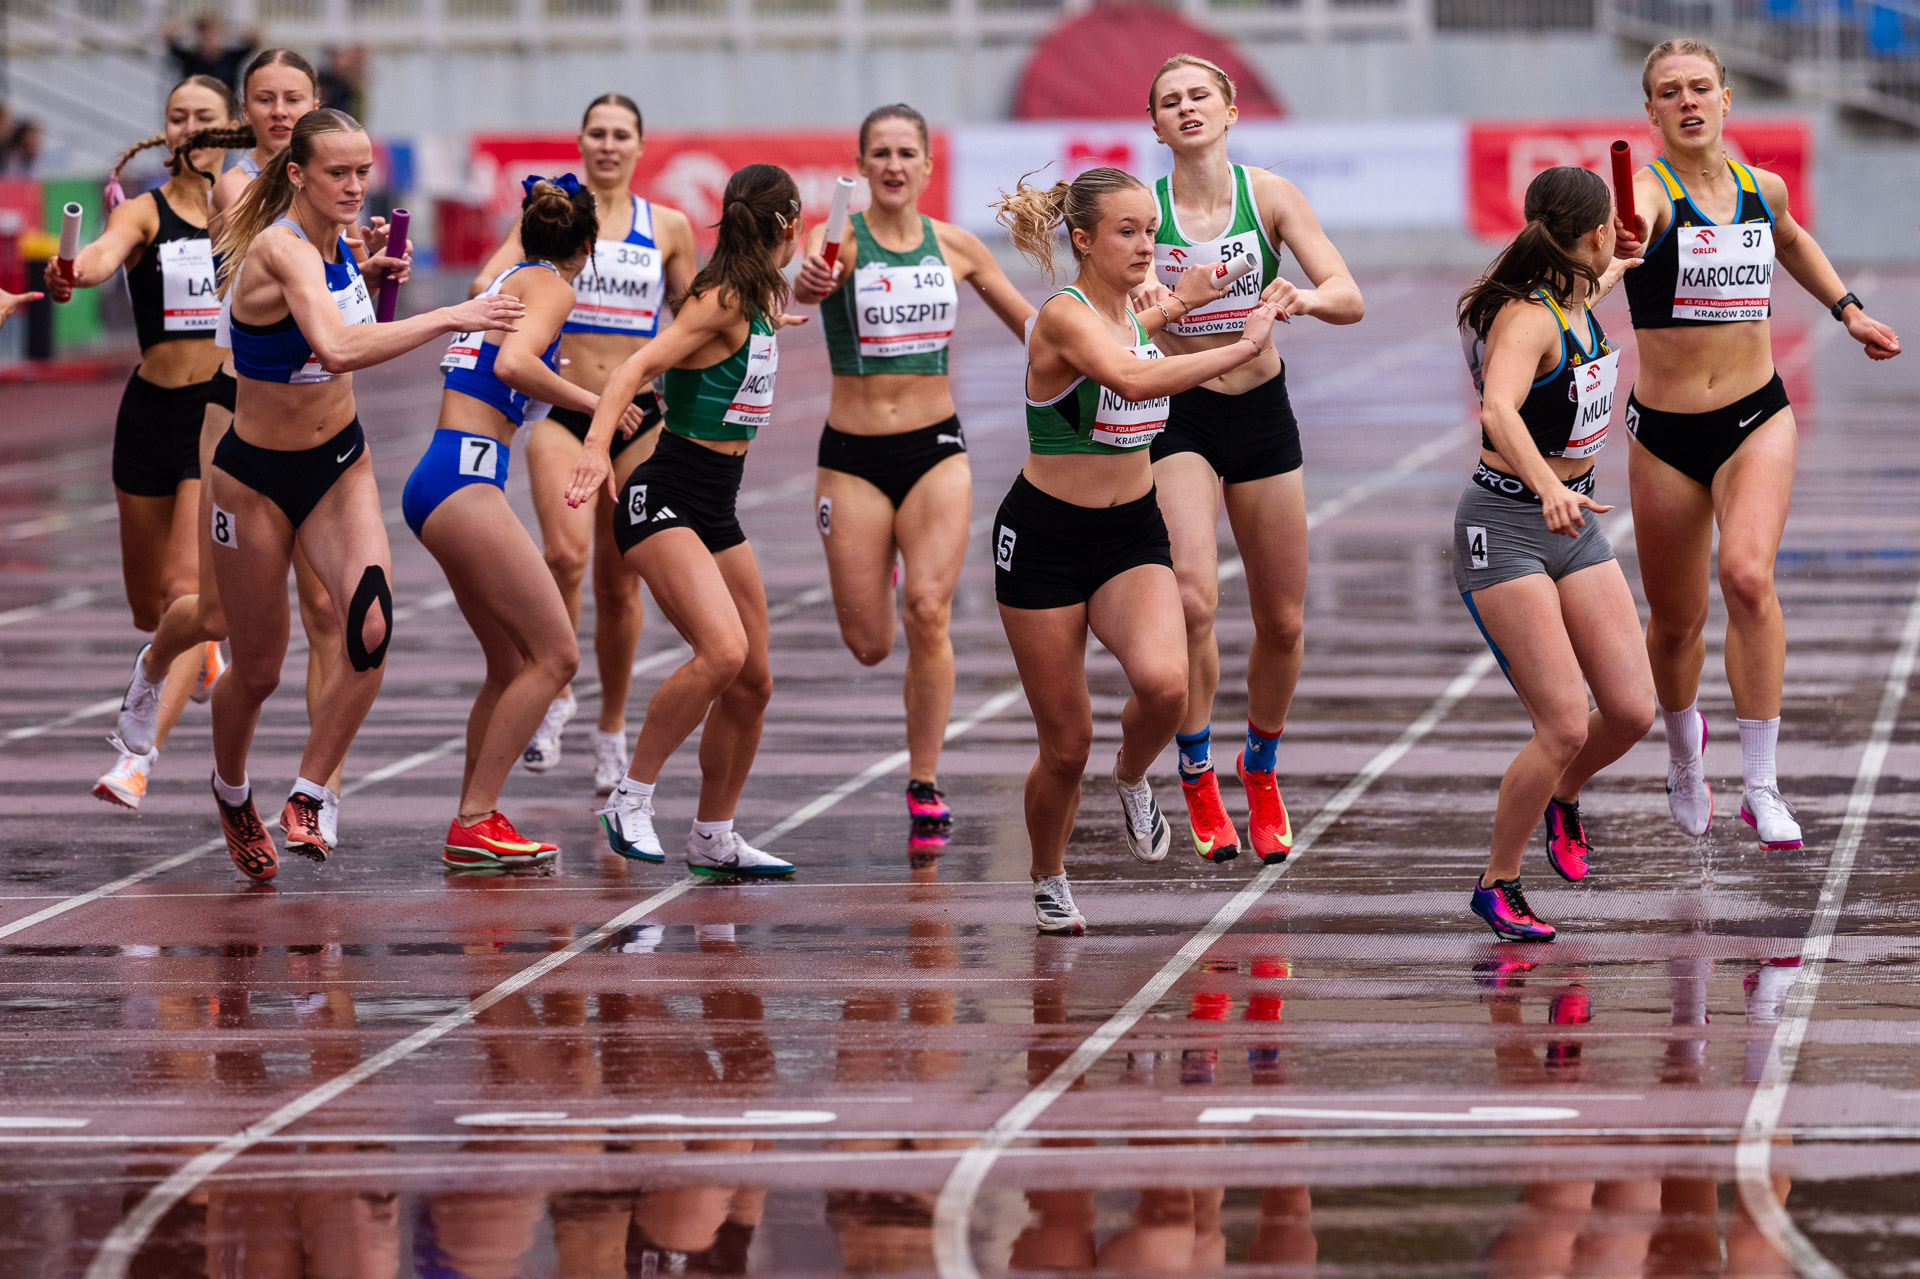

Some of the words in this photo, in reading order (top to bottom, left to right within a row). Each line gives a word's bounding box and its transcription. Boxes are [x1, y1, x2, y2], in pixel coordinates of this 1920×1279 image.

[1742, 230, 1761, 248] 37
[617, 248, 650, 267] 330
[1220, 241, 1245, 263] 58
[1692, 247, 1717, 255] ORLEN
[1166, 265, 1188, 273] ORLE
[1681, 264, 1771, 287] KAROLCZUK
[188, 278, 214, 297] LA
[572, 274, 648, 298] HAMM
[913, 273, 945, 289] 140
[865, 303, 948, 325] GUSZPIT
[1192, 314, 1229, 323] Mistrzostwa
[1230, 310, 1249, 318] Polski
[1694, 309, 1738, 318] KRAKÓW
[1178, 322, 1224, 334] KRAKÓW
[1586, 380, 1602, 392] ORLEN
[1115, 434, 1143, 444] KRAKÓW
[470, 441, 490, 472] 7
[1475, 464, 1523, 493] PRO
[631, 491, 644, 516] 6
[819, 504, 830, 528] 6
[216, 511, 229, 543] 8
[1000, 534, 1013, 562] 5
[1471, 533, 1485, 561] 4
